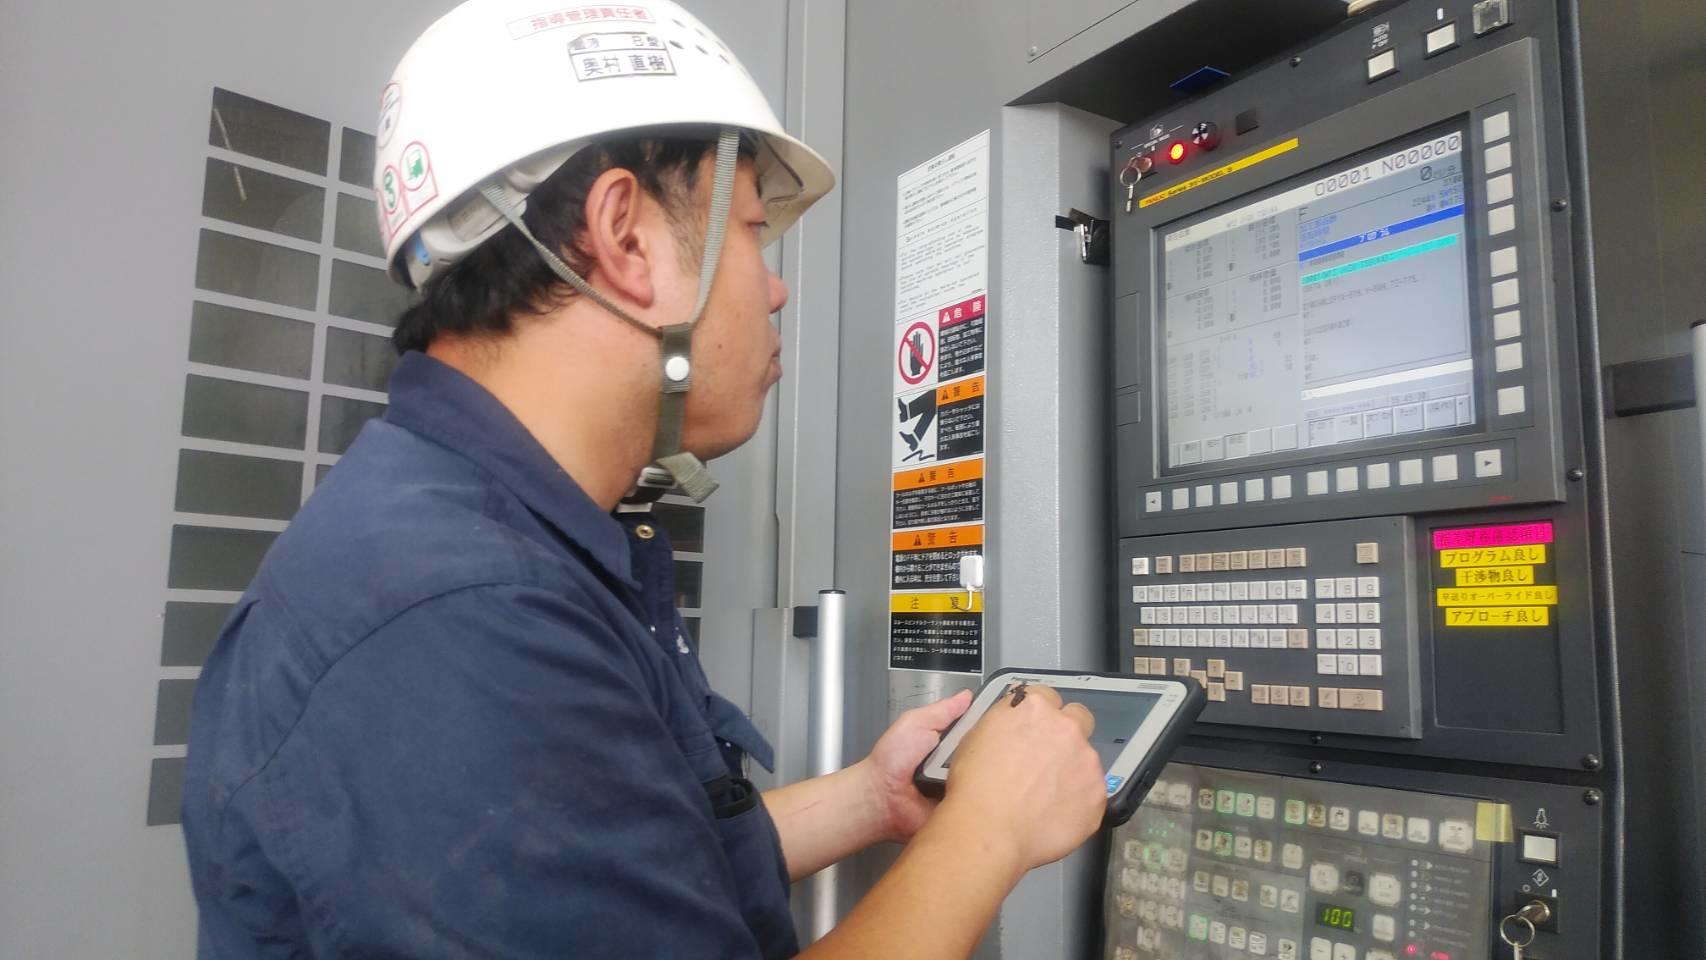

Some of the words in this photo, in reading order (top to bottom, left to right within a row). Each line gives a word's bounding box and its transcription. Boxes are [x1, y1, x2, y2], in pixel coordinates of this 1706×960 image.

[1381, 135, 1460, 175] N00000
[1445, 548, 1540, 565] プログラム良し
[1462, 568, 1528, 584] 干渉物良し
[1343, 584, 1352, 594] 8
[1345, 610, 1353, 620] 5
[1367, 610, 1375, 620] 6
[1451, 609, 1542, 623] アプローチ良し
[1344, 636, 1353, 646] 2
[1367, 636, 1375, 646] 3
[1346, 662, 1354, 672] 0
[1322, 908, 1355, 928] 100
